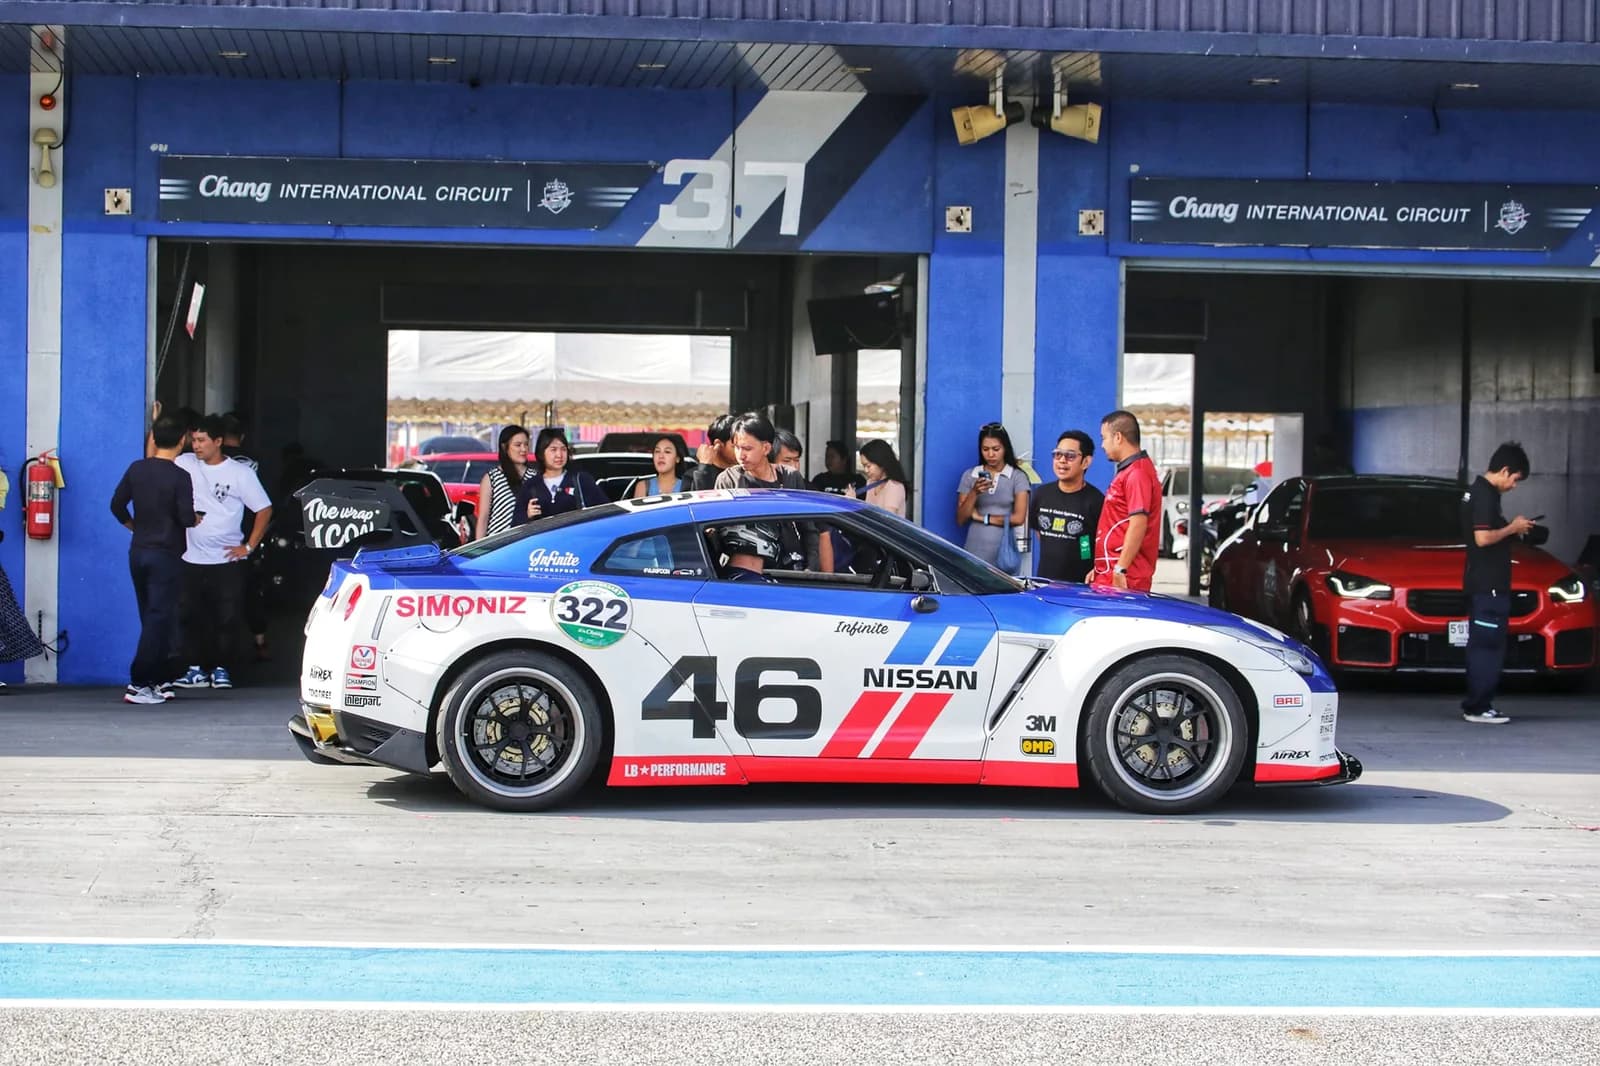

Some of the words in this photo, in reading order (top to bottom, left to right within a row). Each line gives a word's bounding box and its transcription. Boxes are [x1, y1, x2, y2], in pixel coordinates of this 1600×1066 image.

[199, 174, 272, 202] Chang
[280, 184, 427, 201] INTERNATIONAL
[435, 186, 512, 202] CIRCUIT
[659, 158, 806, 235] 37
[1169, 196, 1239, 223] Chang
[1246, 204, 1388, 221] INTERNATIONAL
[1396, 207, 1471, 223] CIRCUIT
[303, 497, 339, 522] The
[340, 506, 374, 523] wrap
[529, 548, 580, 567] Infinite
[396, 595, 527, 617] SIMONIZ
[557, 596, 628, 631] 322
[834, 621, 889, 636] Infinite
[347, 678, 376, 687] CHAMPION
[863, 667, 978, 690] NISSAN
[641, 655, 823, 740] 46
[1276, 697, 1301, 705] BRE
[1025, 714, 1057, 732] 3M
[650, 763, 727, 777] PERFORMANCE
